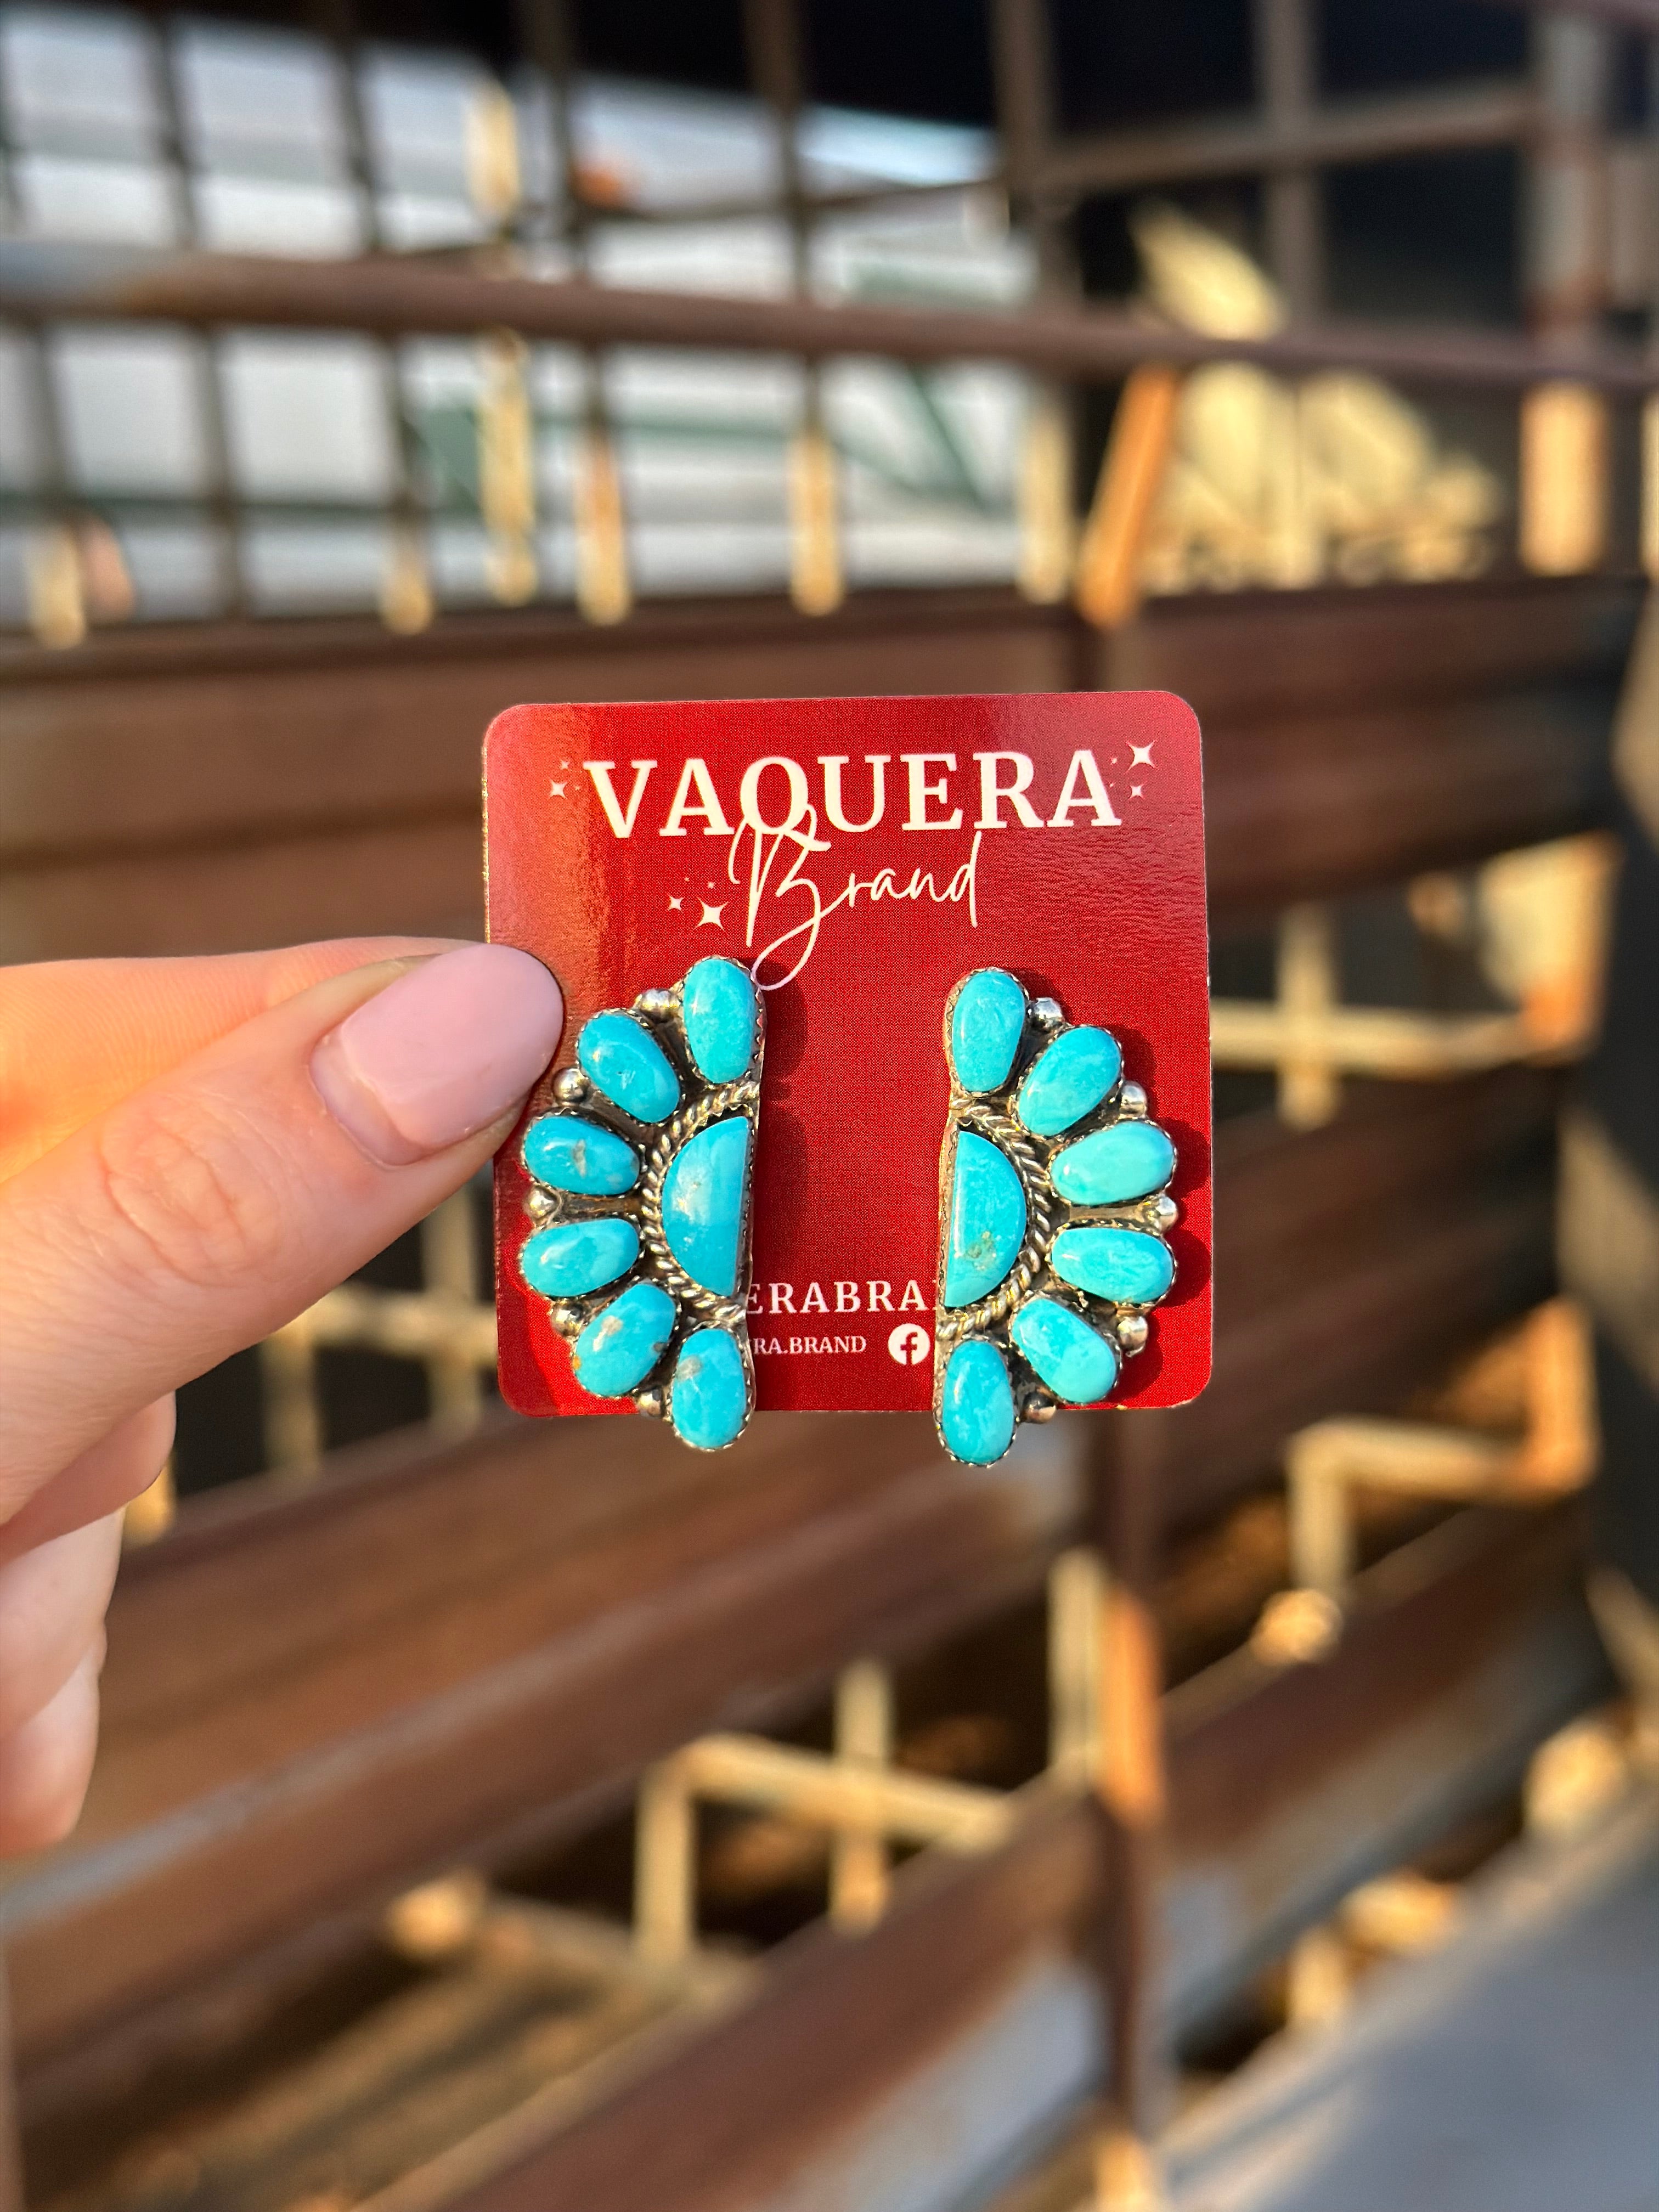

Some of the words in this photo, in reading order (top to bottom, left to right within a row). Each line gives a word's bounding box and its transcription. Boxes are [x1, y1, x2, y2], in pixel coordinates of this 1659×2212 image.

[583, 749, 1122, 851] VAQUERA
[728, 802, 982, 990] Brand
[746, 1280, 936, 1314] ERABRA
[749, 1336, 866, 1354] RA.BRAND
